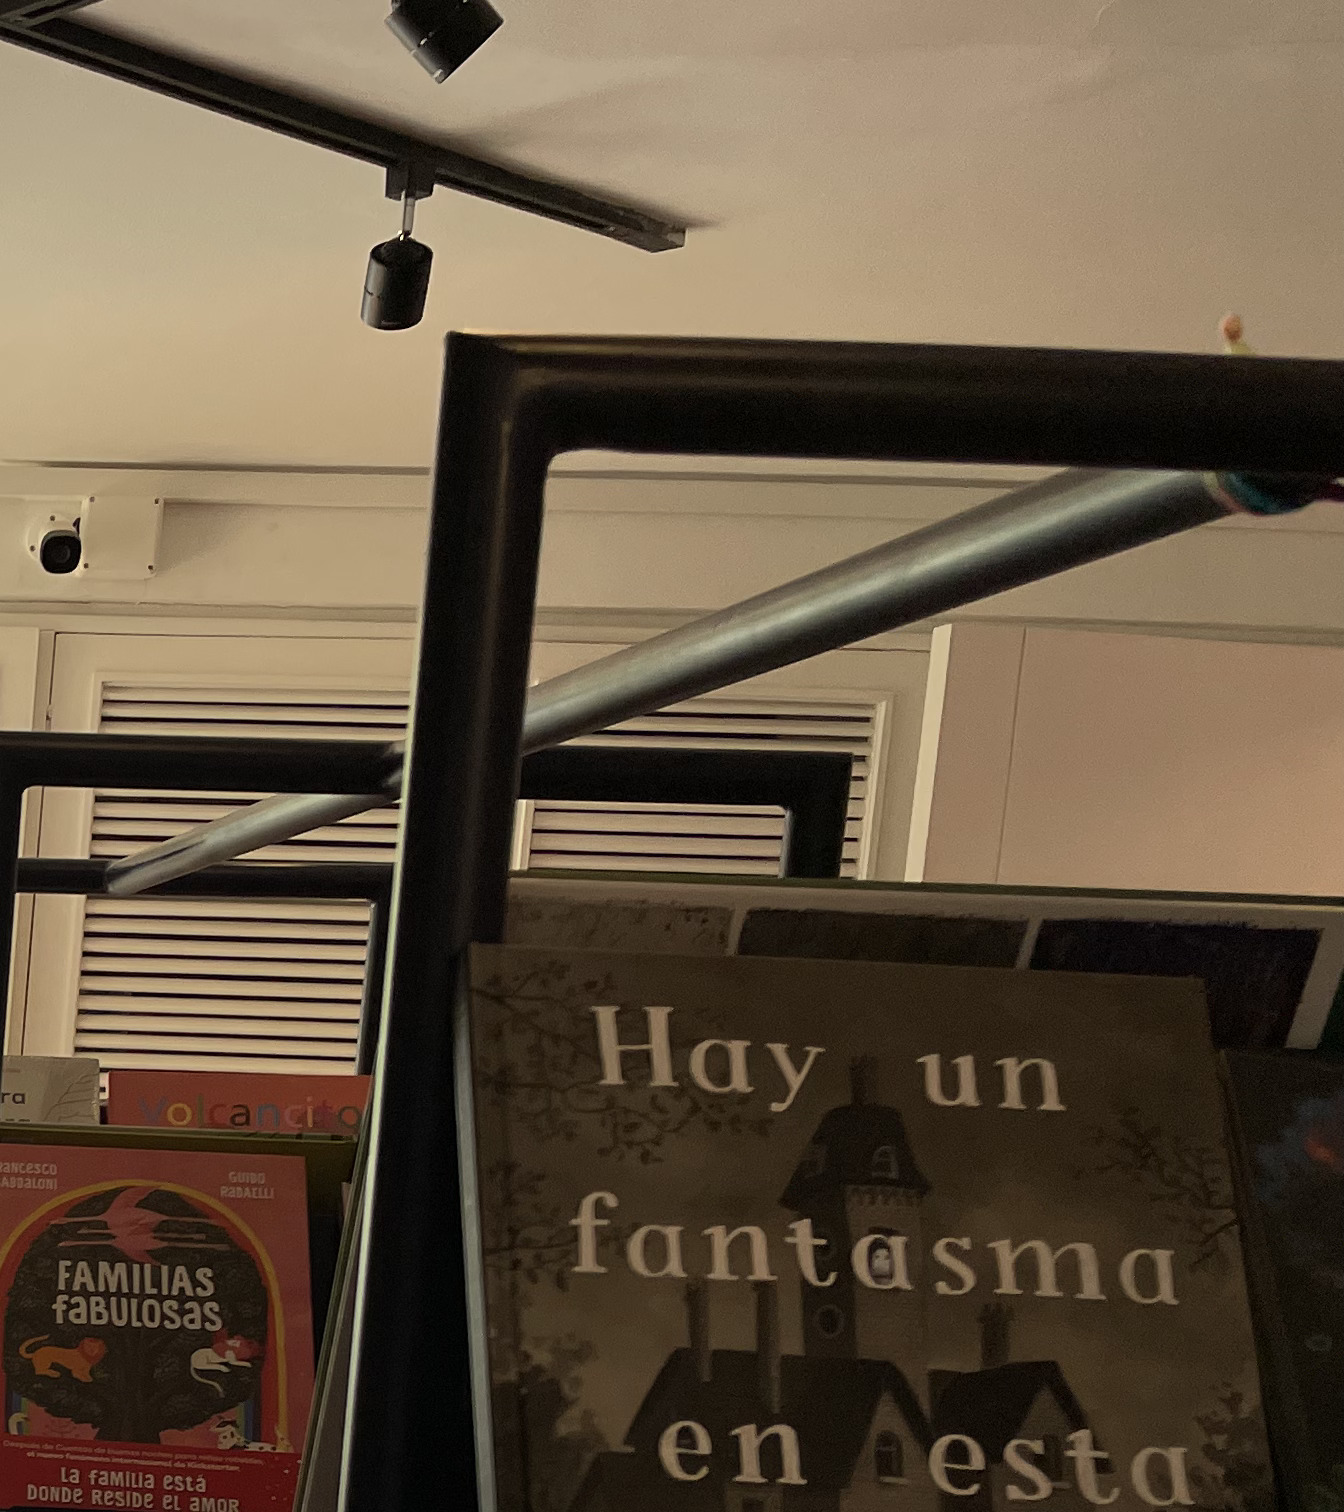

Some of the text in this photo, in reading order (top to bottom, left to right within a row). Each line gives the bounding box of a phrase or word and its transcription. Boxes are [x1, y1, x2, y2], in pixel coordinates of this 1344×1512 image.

[590, 1005, 1067, 1113] Hay un
[57, 1259, 216, 1298] FAMILIAS
[569, 1191, 1182, 1307] fantasma
[657, 1417, 1198, 1508] en esta
